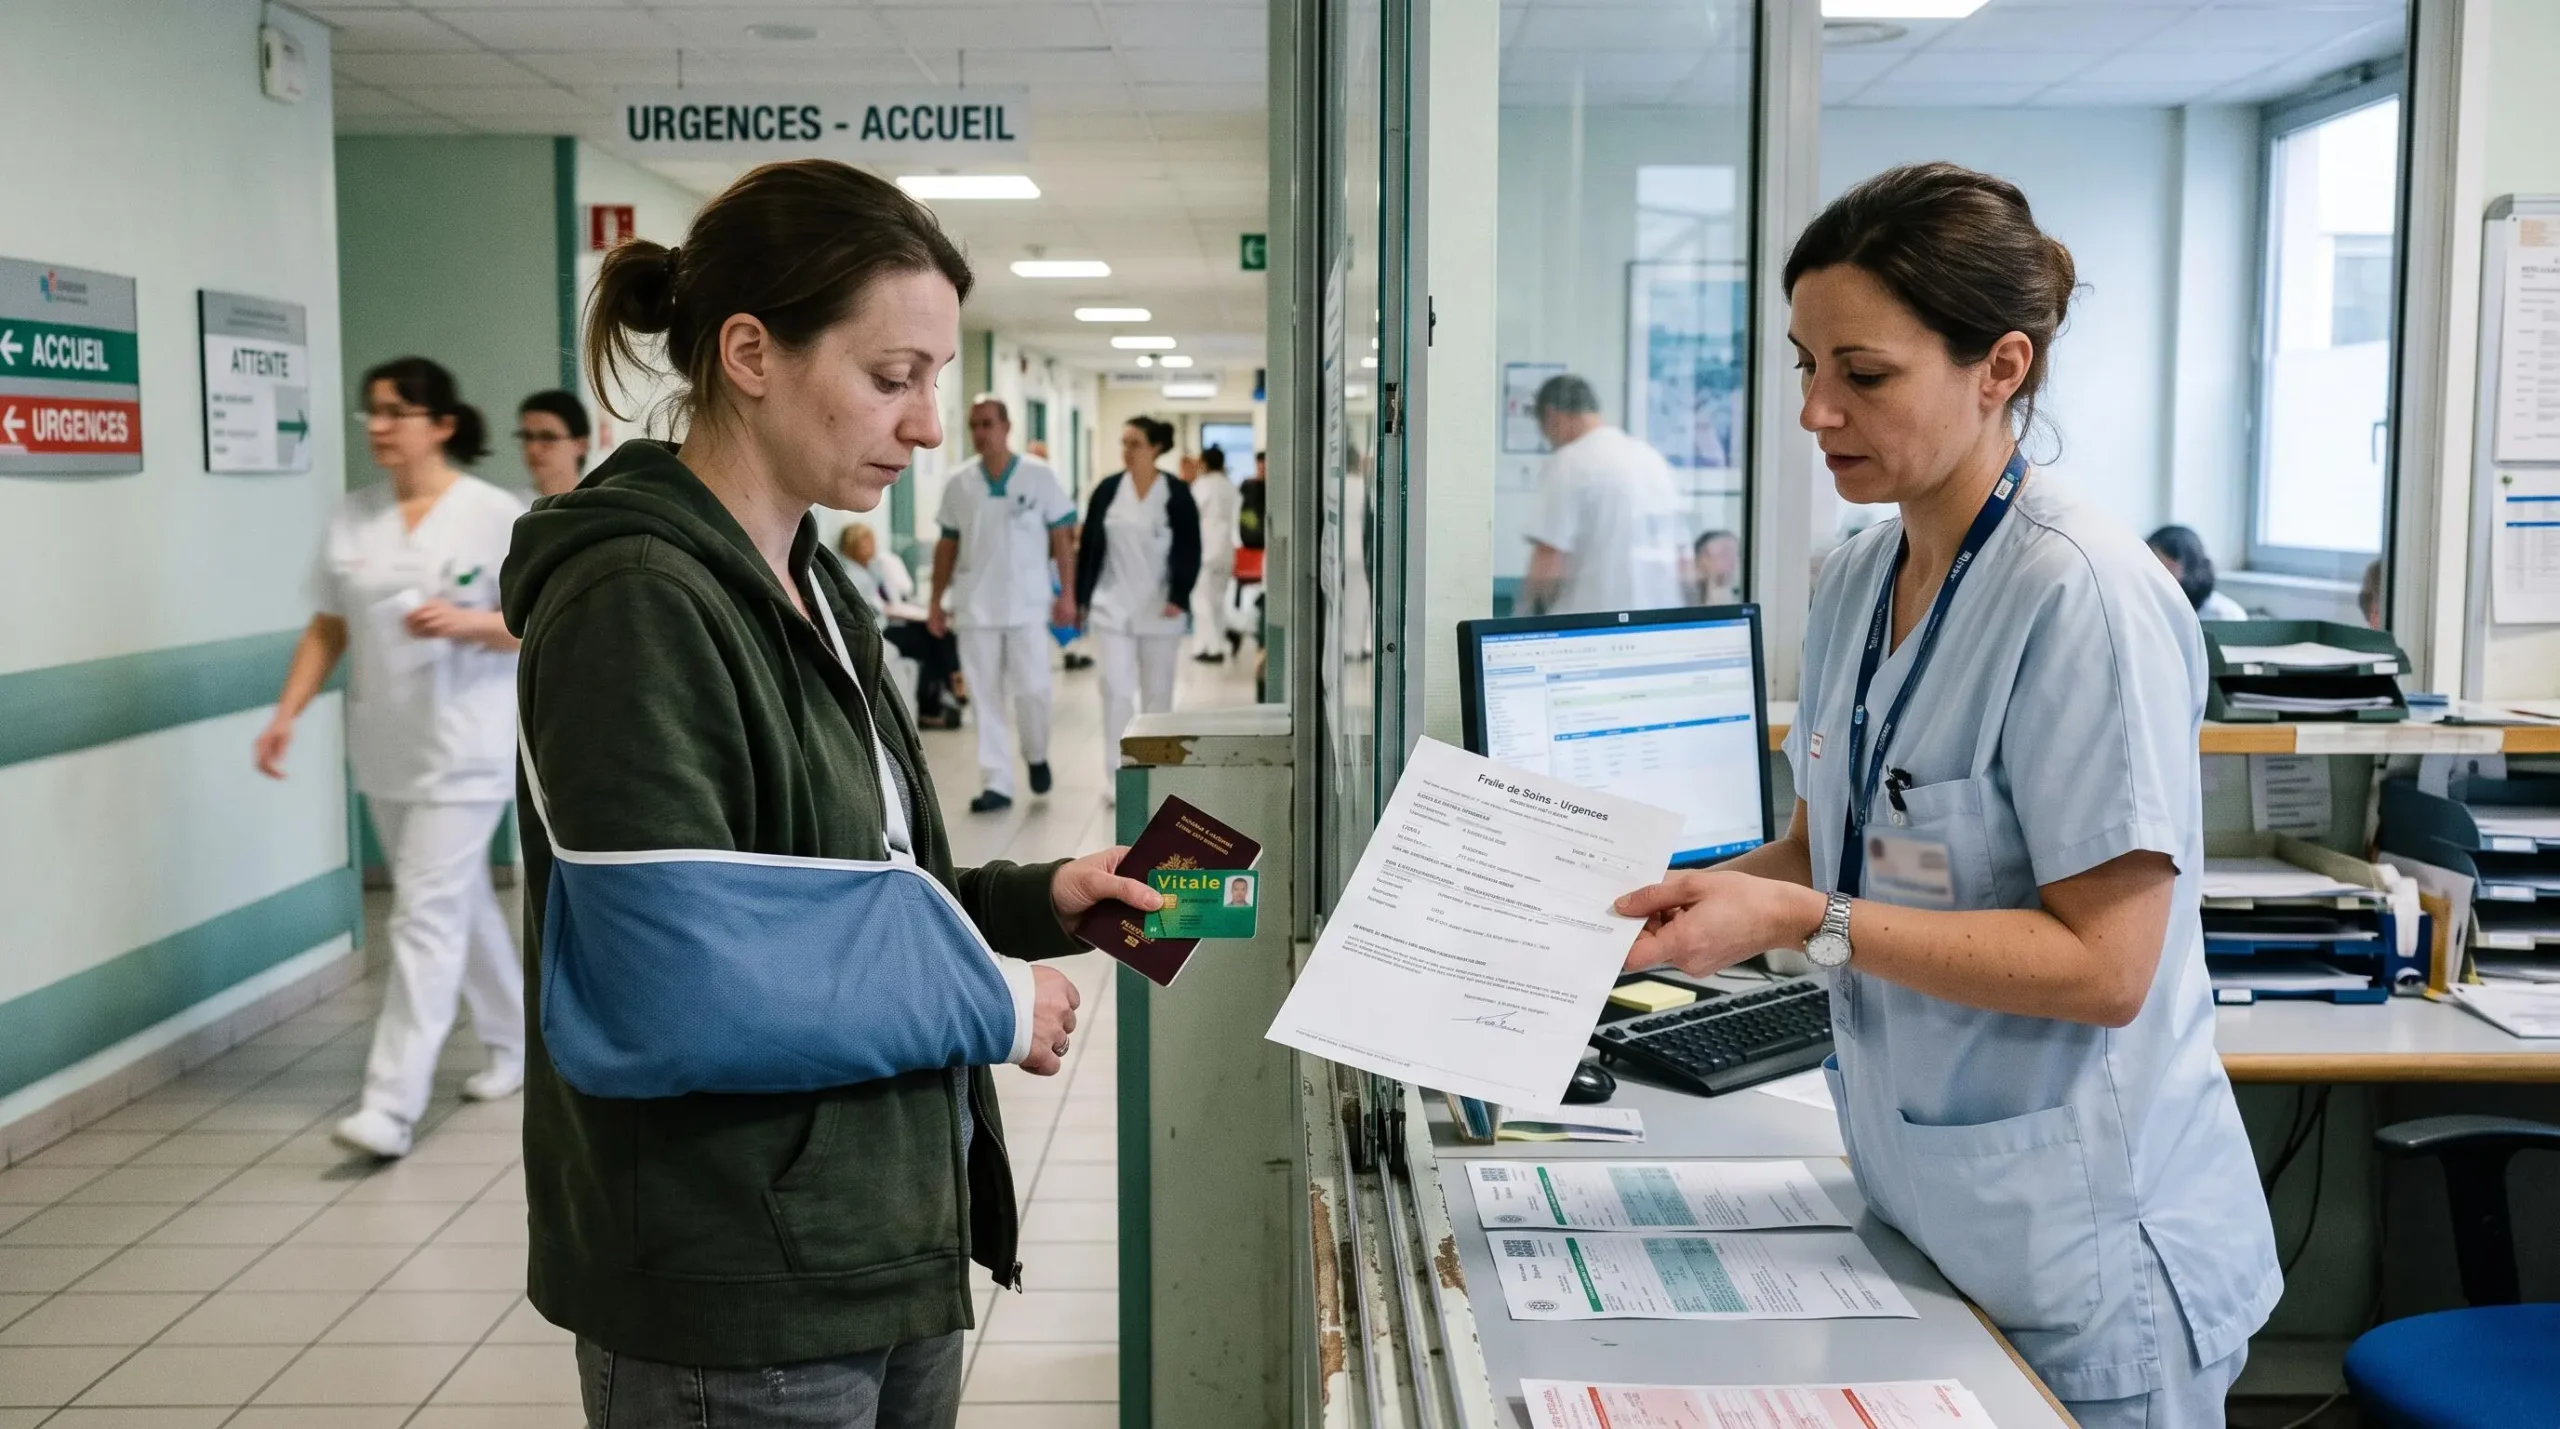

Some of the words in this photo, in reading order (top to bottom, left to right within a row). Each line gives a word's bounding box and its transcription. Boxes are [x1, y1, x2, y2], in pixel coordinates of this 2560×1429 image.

[627, 105, 821, 141] URGENCES
[860, 105, 1014, 141] ACCUEIL
[31, 333, 109, 372] ACCUEIL
[231, 346, 289, 378] ATTENTE
[32, 408, 129, 443] URGENCES
[1507, 783, 1520, 795] de
[1522, 788, 1551, 805] Soins
[1560, 799, 1609, 821] Urgences
[1157, 874, 1220, 890] Vitale
